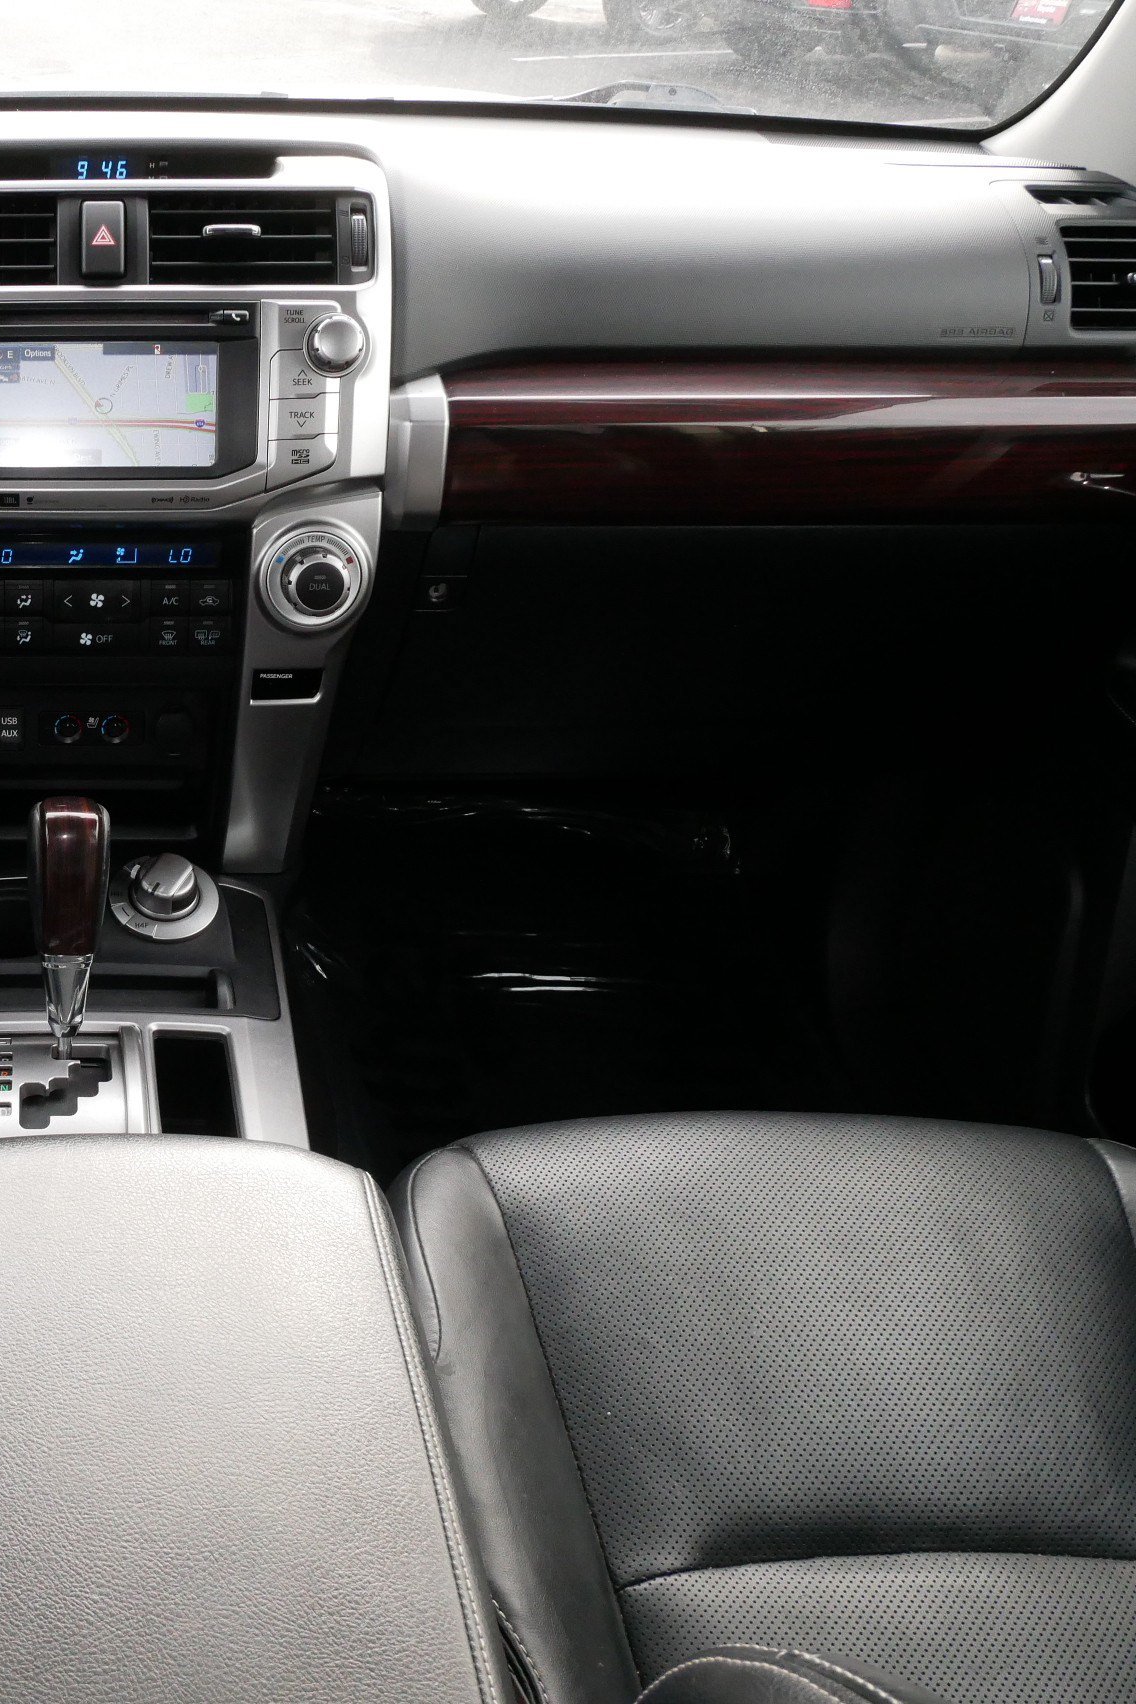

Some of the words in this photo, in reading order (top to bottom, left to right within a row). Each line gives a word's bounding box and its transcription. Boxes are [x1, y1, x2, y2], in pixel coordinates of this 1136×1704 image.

[7, 350, 14, 358] E
[24, 348, 52, 358] Options
[307, 535, 326, 544] TEMP
[309, 583, 330, 591] DUAL
[162, 597, 179, 606] A/C
[96, 634, 114, 644] OFF
[1, 717, 18, 726] USB
[1, 729, 18, 737] AUX
